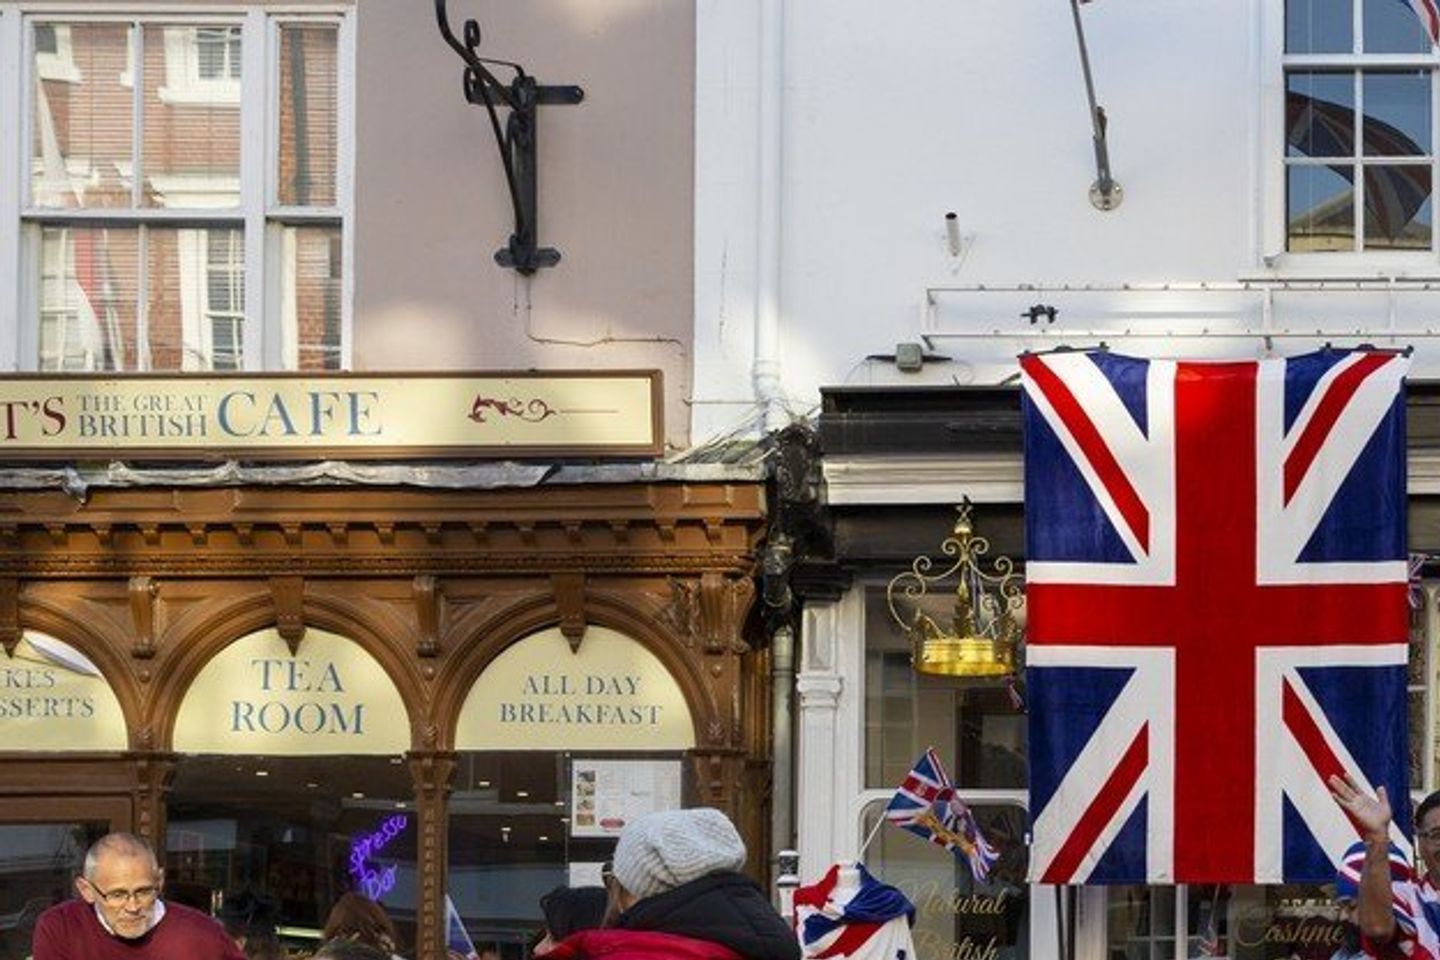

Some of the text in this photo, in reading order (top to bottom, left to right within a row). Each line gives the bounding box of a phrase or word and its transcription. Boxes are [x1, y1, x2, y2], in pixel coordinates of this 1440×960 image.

[76, 393, 125, 412] THE
[133, 393, 209, 412] GREAT
[78, 390, 382, 437] BRITISH CAFE
[252, 658, 346, 693] TEA
[523, 674, 641, 696] ALL DAY
[231, 700, 366, 735] ROOM
[500, 702, 664, 726] BREAKFAST
